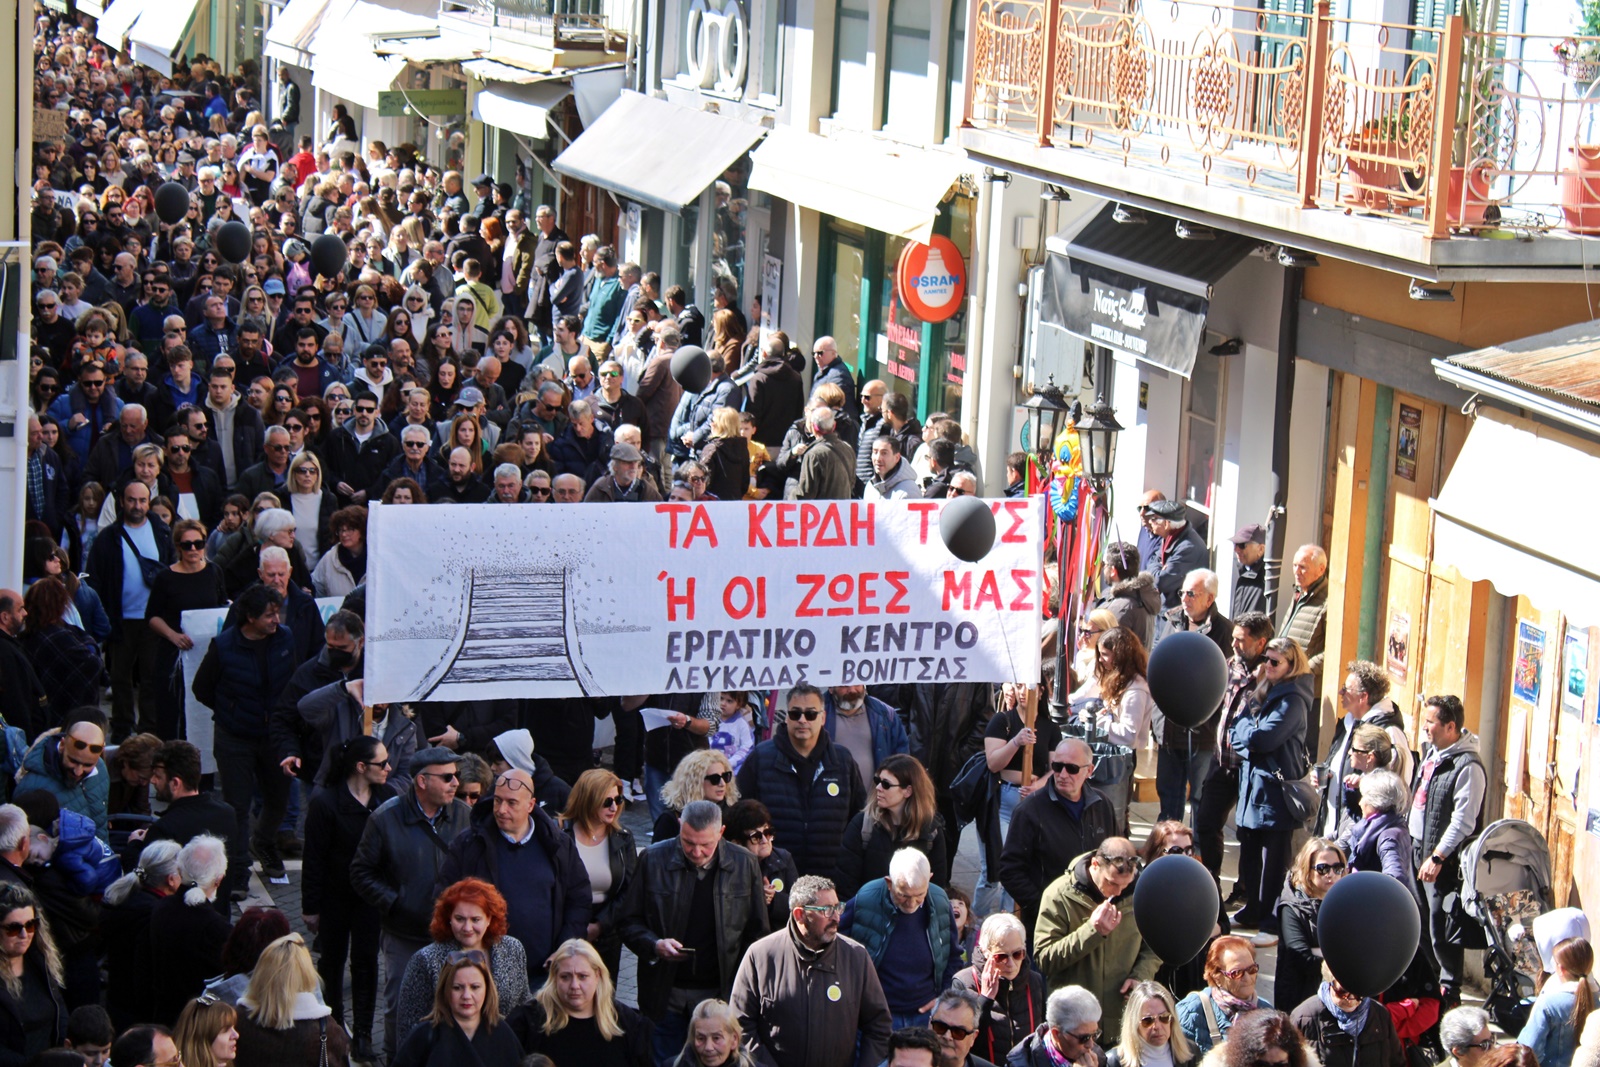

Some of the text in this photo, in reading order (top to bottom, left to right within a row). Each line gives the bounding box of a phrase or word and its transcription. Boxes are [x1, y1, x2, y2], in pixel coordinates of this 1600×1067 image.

[910, 274, 960, 288] OSRAM
[655, 501, 1028, 549] ΤΑ ΚΕΡΔΗ ΤΣ
[723, 576, 766, 620] ΟΙ
[795, 571, 910, 617] ΖΩΕΣ
[941, 569, 1036, 611] ΜΑΣ
[666, 621, 979, 663] ΕΡΓΑΤΙΚΟ ΚΕΝΤΡΟ
[665, 664, 809, 690] ΛΕΥΚΑΔΑΣ
[842, 656, 967, 684] ΒΟΝΙΤΣΑΣ
